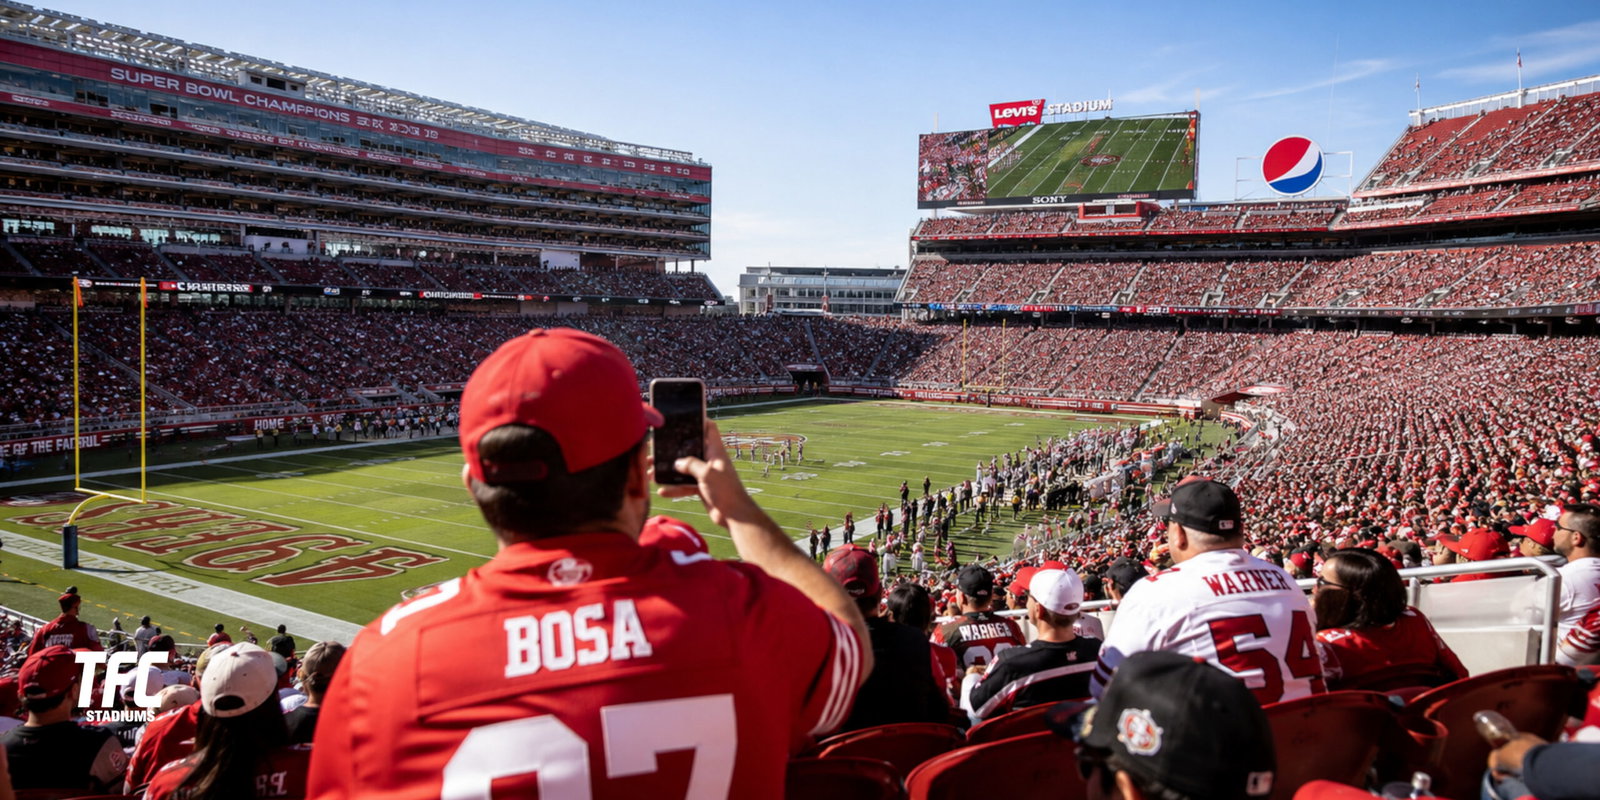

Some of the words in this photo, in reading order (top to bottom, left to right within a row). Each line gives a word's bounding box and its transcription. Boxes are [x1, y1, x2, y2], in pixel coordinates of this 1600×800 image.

[111, 67, 180, 91] SUPER
[185, 82, 240, 103] BOWL
[1047, 98, 1113, 116] STADIUM
[1032, 195, 1067, 204] SONY
[254, 418, 285, 431] HOME
[1202, 569, 1293, 597] WARNER
[504, 599, 653, 678] BOSA
[1207, 609, 1328, 706] 54
